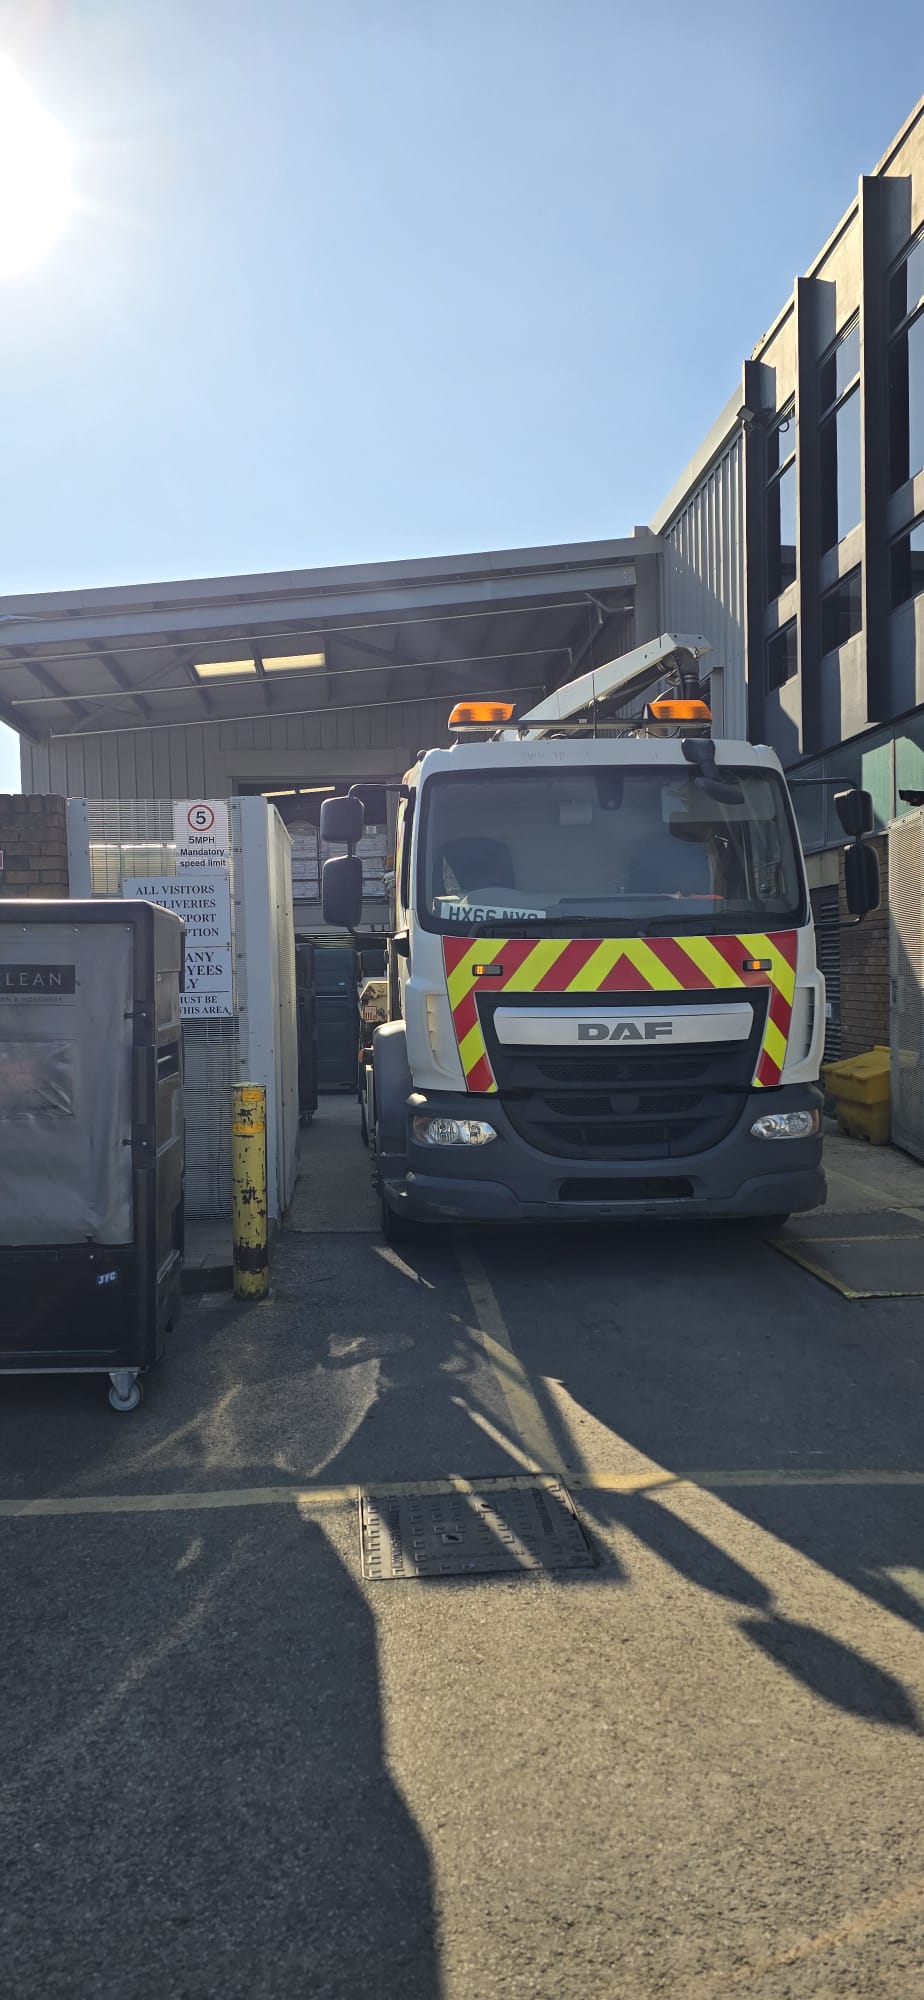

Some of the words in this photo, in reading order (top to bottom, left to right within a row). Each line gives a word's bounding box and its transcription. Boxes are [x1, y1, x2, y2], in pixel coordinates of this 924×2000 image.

[195, 811, 206, 825] 5
[189, 836, 215, 844] 5MPH
[180, 848, 225, 857] Mandatory
[180, 859, 205, 868] speed
[208, 859, 226, 867] limit
[136, 886, 159, 895] ALL
[162, 885, 215, 894] VISITORS
[155, 899, 216, 909] ELIVERIES
[179, 913, 217, 923] EPORT
[185, 928, 219, 937] PTION
[185, 951, 214, 963] ANY
[186, 965, 223, 976] YEES
[0, 972, 62, 986] LEAN
[180, 996, 202, 1004] UST
[205, 995, 218, 1003] BE
[202, 1006, 229, 1014] AREA
[578, 1022, 672, 1040] DAF
